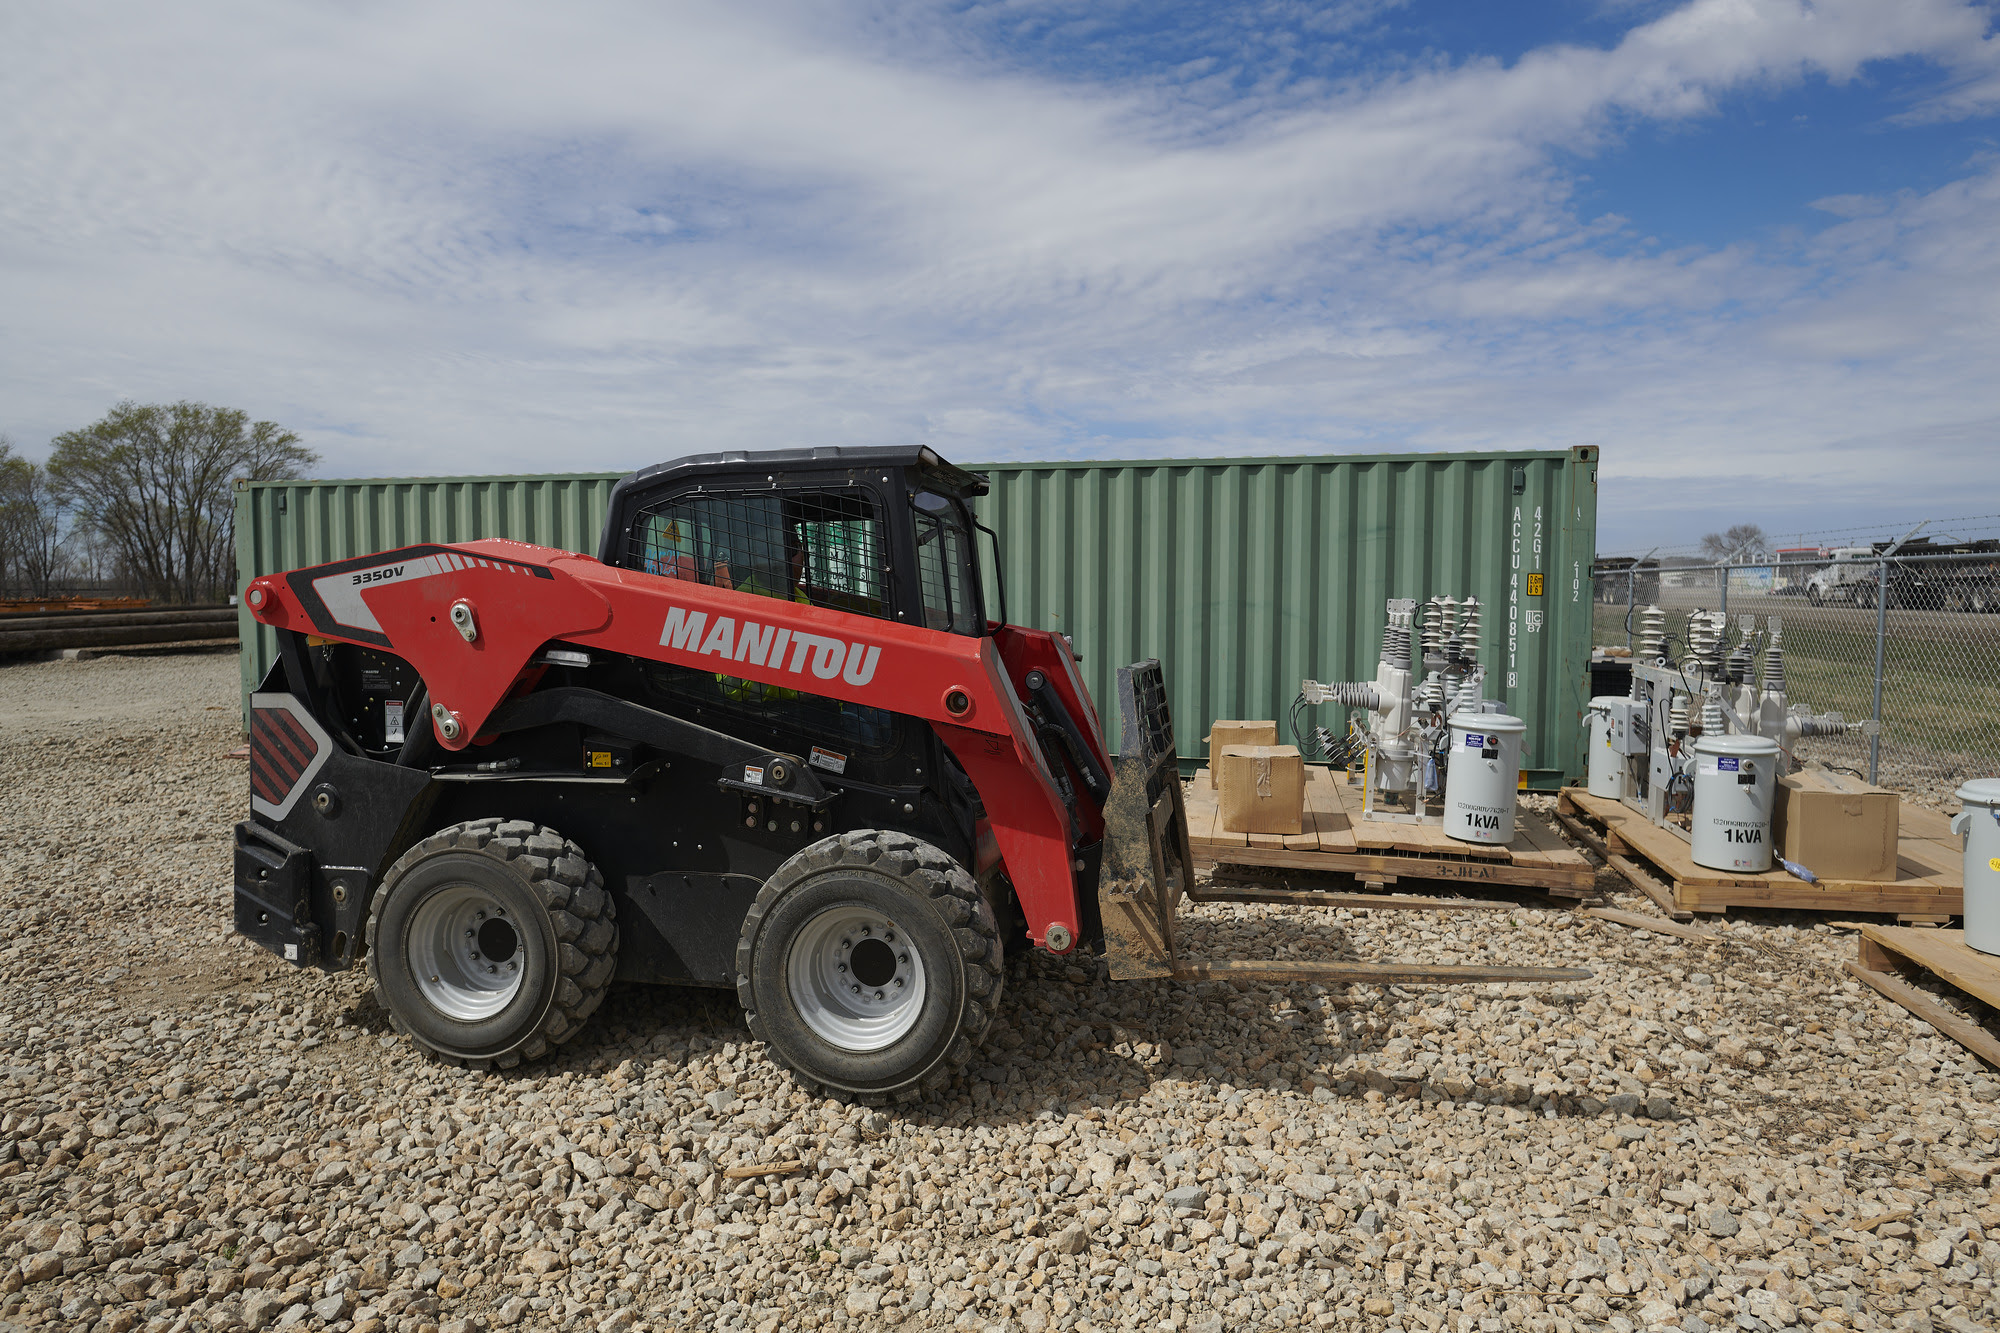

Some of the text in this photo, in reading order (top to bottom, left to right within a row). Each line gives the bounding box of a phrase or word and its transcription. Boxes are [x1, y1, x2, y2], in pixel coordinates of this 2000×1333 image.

[1533, 506, 1542, 569] 42G1
[352, 565, 404, 586] 3350V
[1508, 506, 1521, 687] ACCU 440851 8
[658, 606, 882, 686] MANITOU
[1527, 624, 1541, 633] 87
